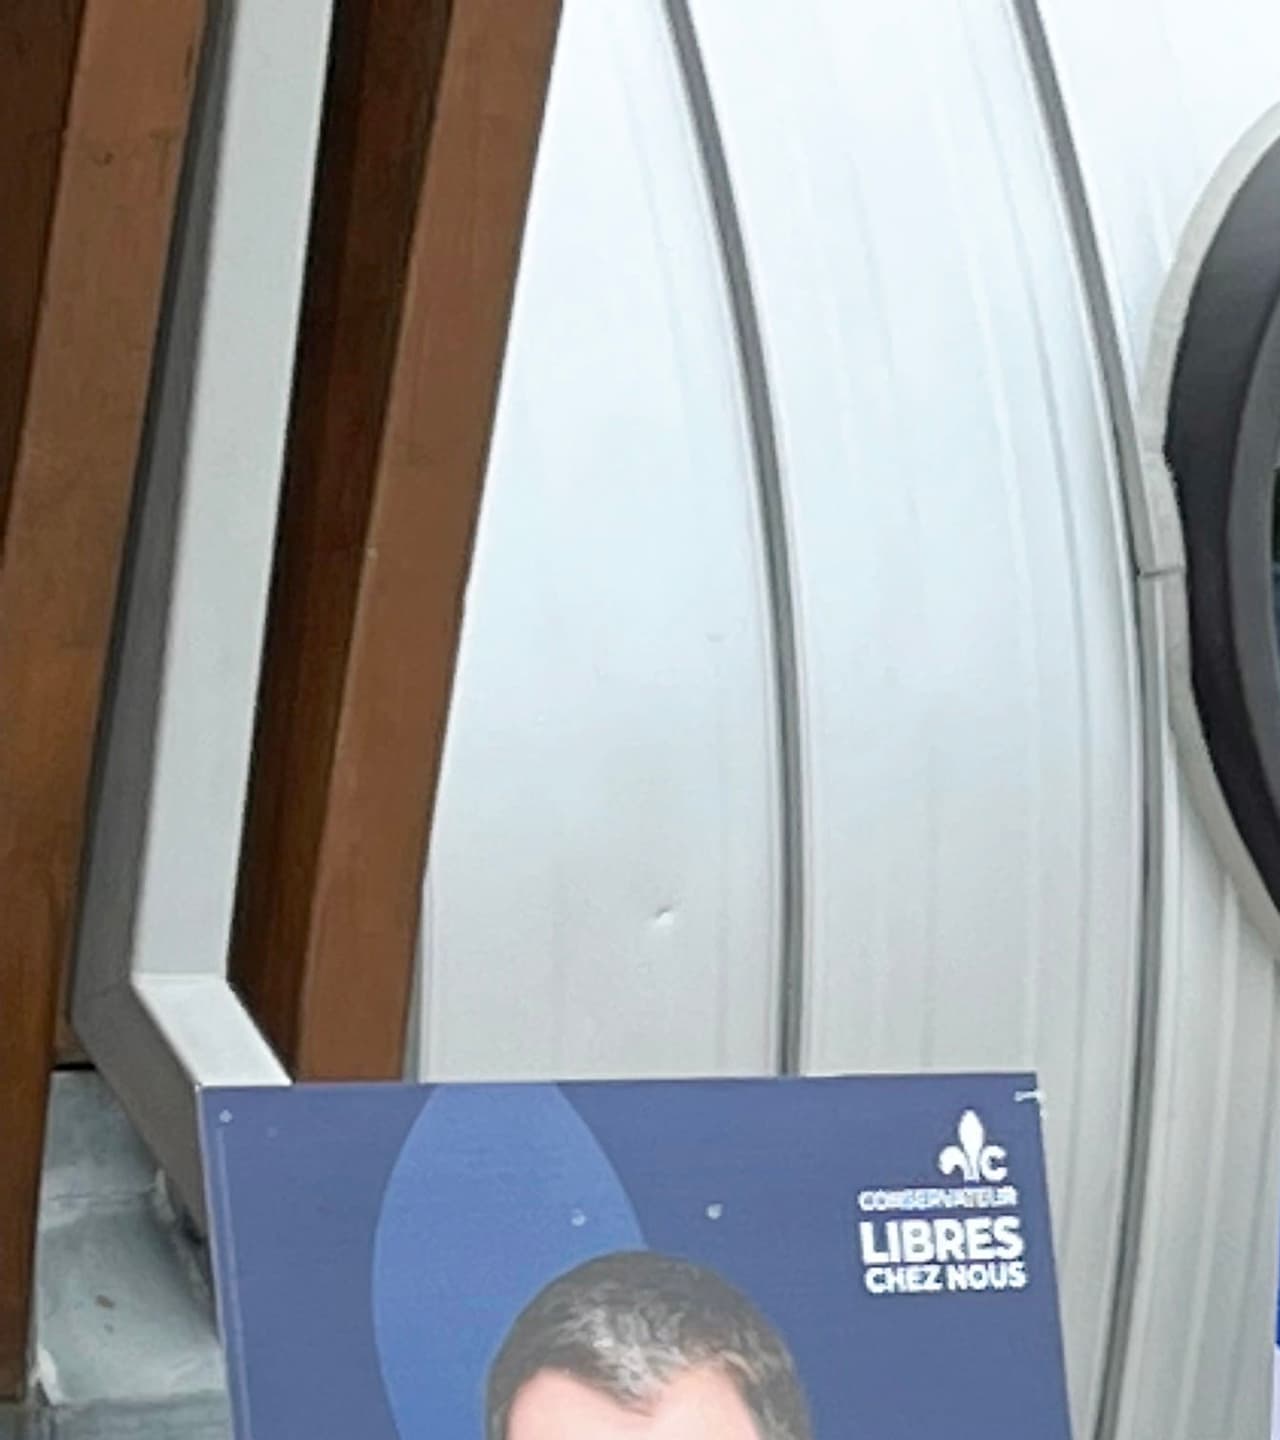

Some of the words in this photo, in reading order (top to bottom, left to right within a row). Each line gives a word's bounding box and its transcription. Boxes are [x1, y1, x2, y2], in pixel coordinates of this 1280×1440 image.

[859, 1216, 1024, 1265] LIBRES
[864, 1264, 943, 1294] CHEZ
[946, 1260, 1027, 1291] NOUS
